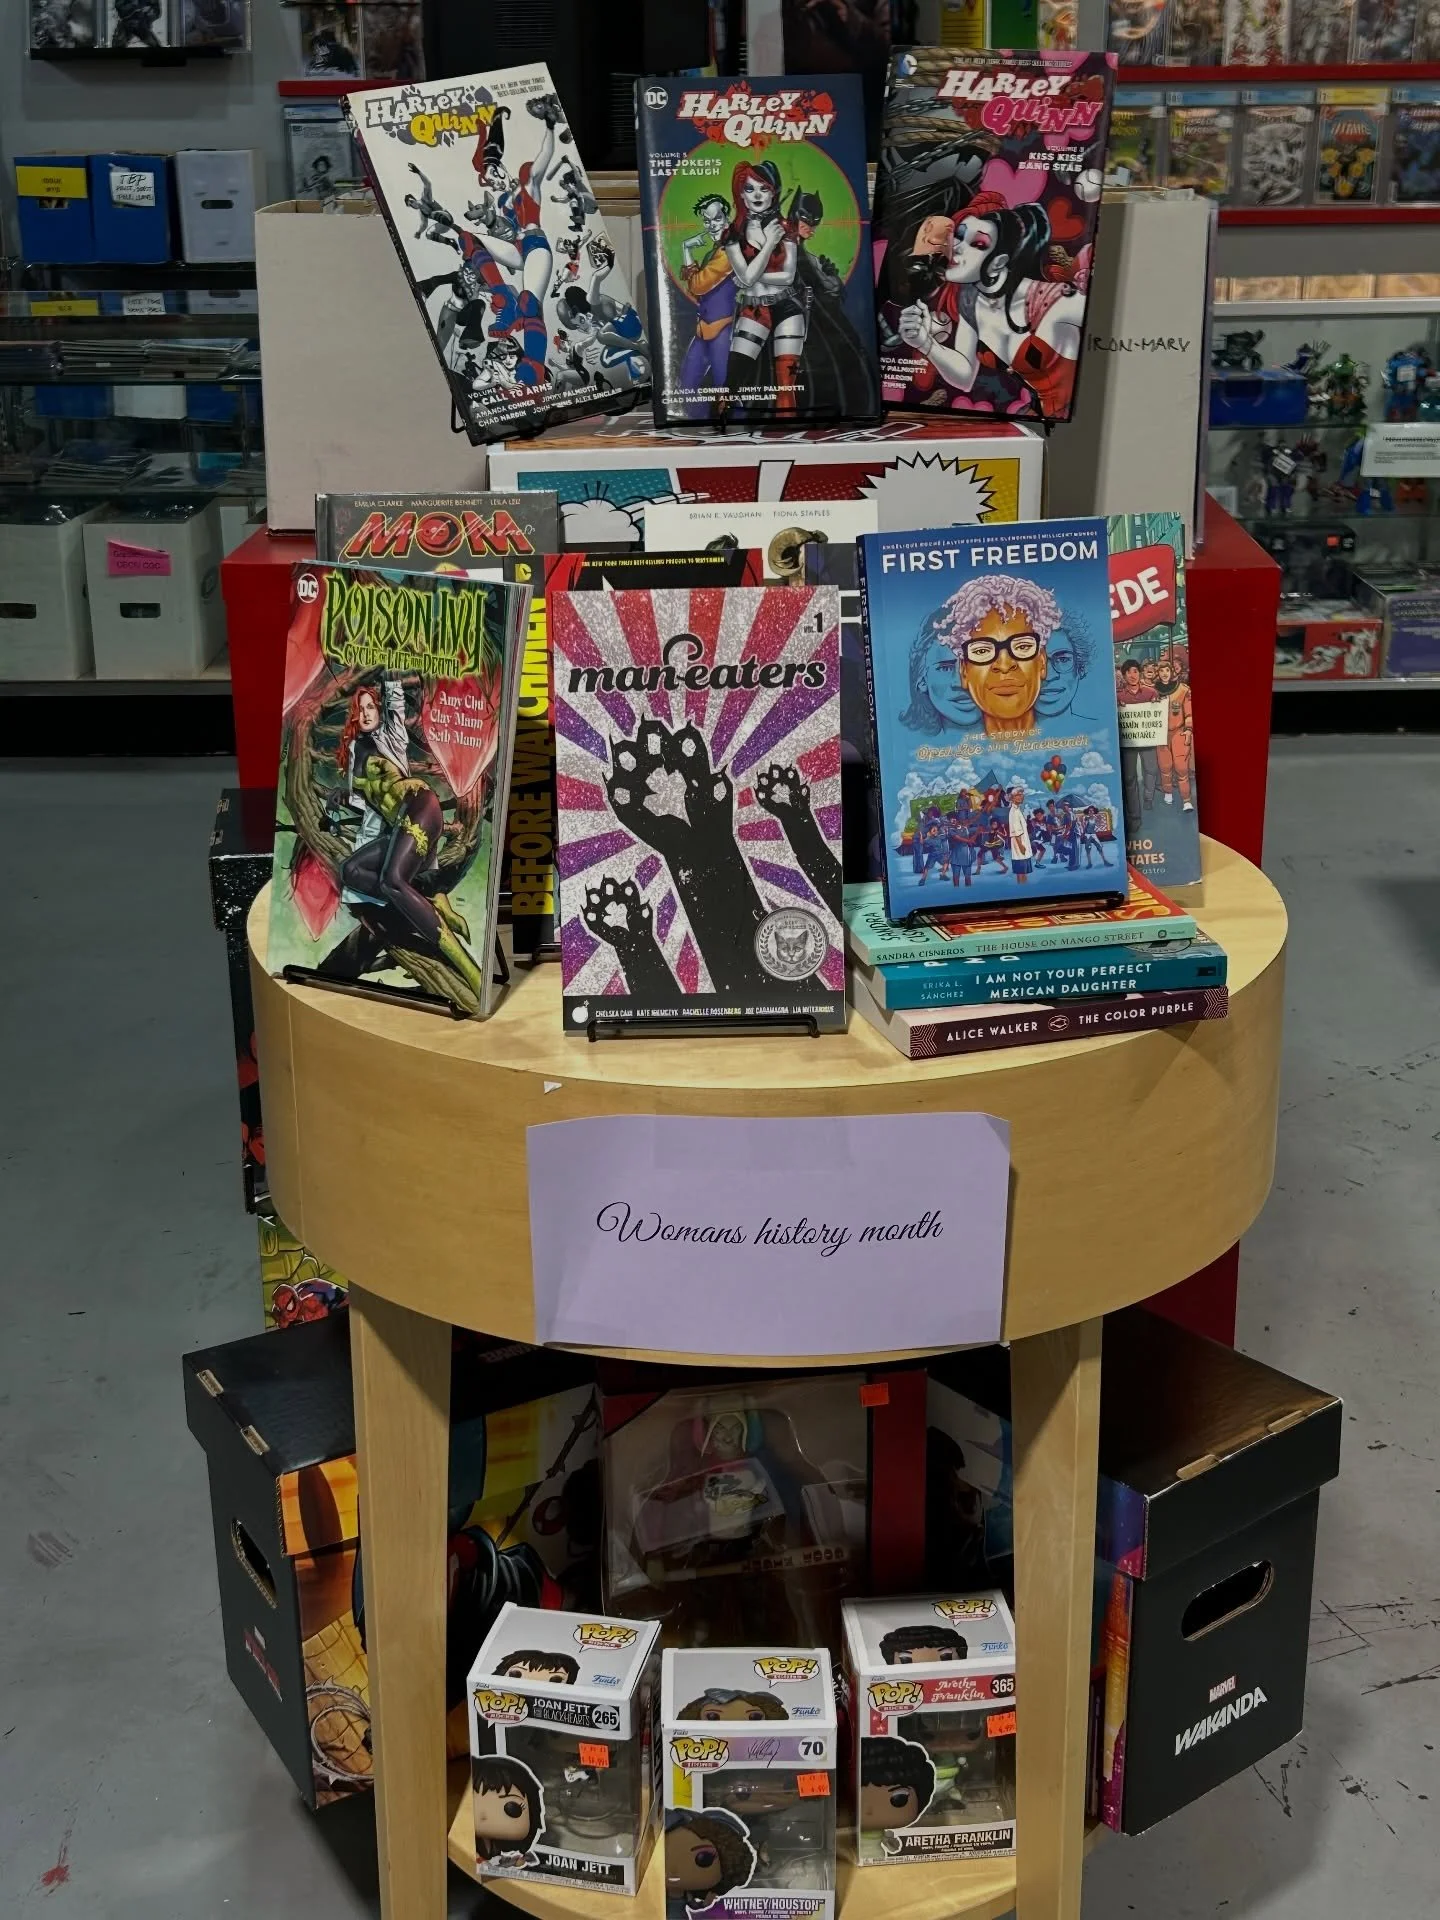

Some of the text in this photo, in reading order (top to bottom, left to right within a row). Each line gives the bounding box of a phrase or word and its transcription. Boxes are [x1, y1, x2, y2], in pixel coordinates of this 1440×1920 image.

[649, 158, 722, 168] THE JOKER'S
[1029, 152, 1085, 162] KISS KISS
[650, 167, 720, 177] LAST LAUGH
[472, 381, 554, 409] A CALL TO ARMS
[882, 540, 1098, 574] FIRST FREEDOM
[1109, 566, 1169, 619] DE
[323, 573, 488, 676] POISON IVY
[344, 645, 378, 665] CYCLE
[387, 649, 410, 671] LIFE
[423, 653, 460, 677] DEATH
[439, 691, 484, 710] Amy Chu
[430, 708, 483, 731] Clay Mann
[428, 728, 482, 748] Seth Mann
[990, 730, 1030, 740] STORY
[510, 792, 554, 915] BEFORE
[877, 932, 1144, 962] SANDRA CISNEROS THE HOUSE ON MANGO STREET
[986, 973, 1007, 984] AM
[1012, 970, 1041, 982] NOT
[1046, 967, 1085, 979] YOUR
[1091, 963, 1152, 977] PERFECT
[922, 981, 953, 989] ERIKA
[990, 979, 1138, 1000] MEXICAN DAUGHTER
[946, 1001, 1195, 1043] ALICE WALKER THE COLOR PURPLE
[596, 1201, 944, 1258] Womans history month
[932, 1599, 994, 1615] POP!
[577, 1623, 640, 1644] POP!
[980, 1641, 1010, 1652] Funko
[754, 1656, 819, 1676] POP!
[591, 1673, 622, 1686] Funko
[992, 1678, 1015, 1695] 365
[1209, 1675, 1236, 1704] MARVEL
[473, 1688, 527, 1716] POP!
[867, 1681, 924, 1708] POP!
[532, 1698, 591, 1715] JOAN JETT
[791, 1707, 821, 1716] Funko
[594, 1709, 618, 1726] 265
[1174, 1686, 1268, 1757] WAKANDA
[669, 1736, 729, 1763] POP!
[801, 1741, 824, 1756] 70
[905, 1835, 951, 1848] ARETHA
[955, 1828, 1011, 1844] FRANKLIN
[545, 1854, 578, 1871] JOAN
[582, 1859, 611, 1875] JETT
[724, 1898, 820, 1911] WHITNEY HOUSTON
